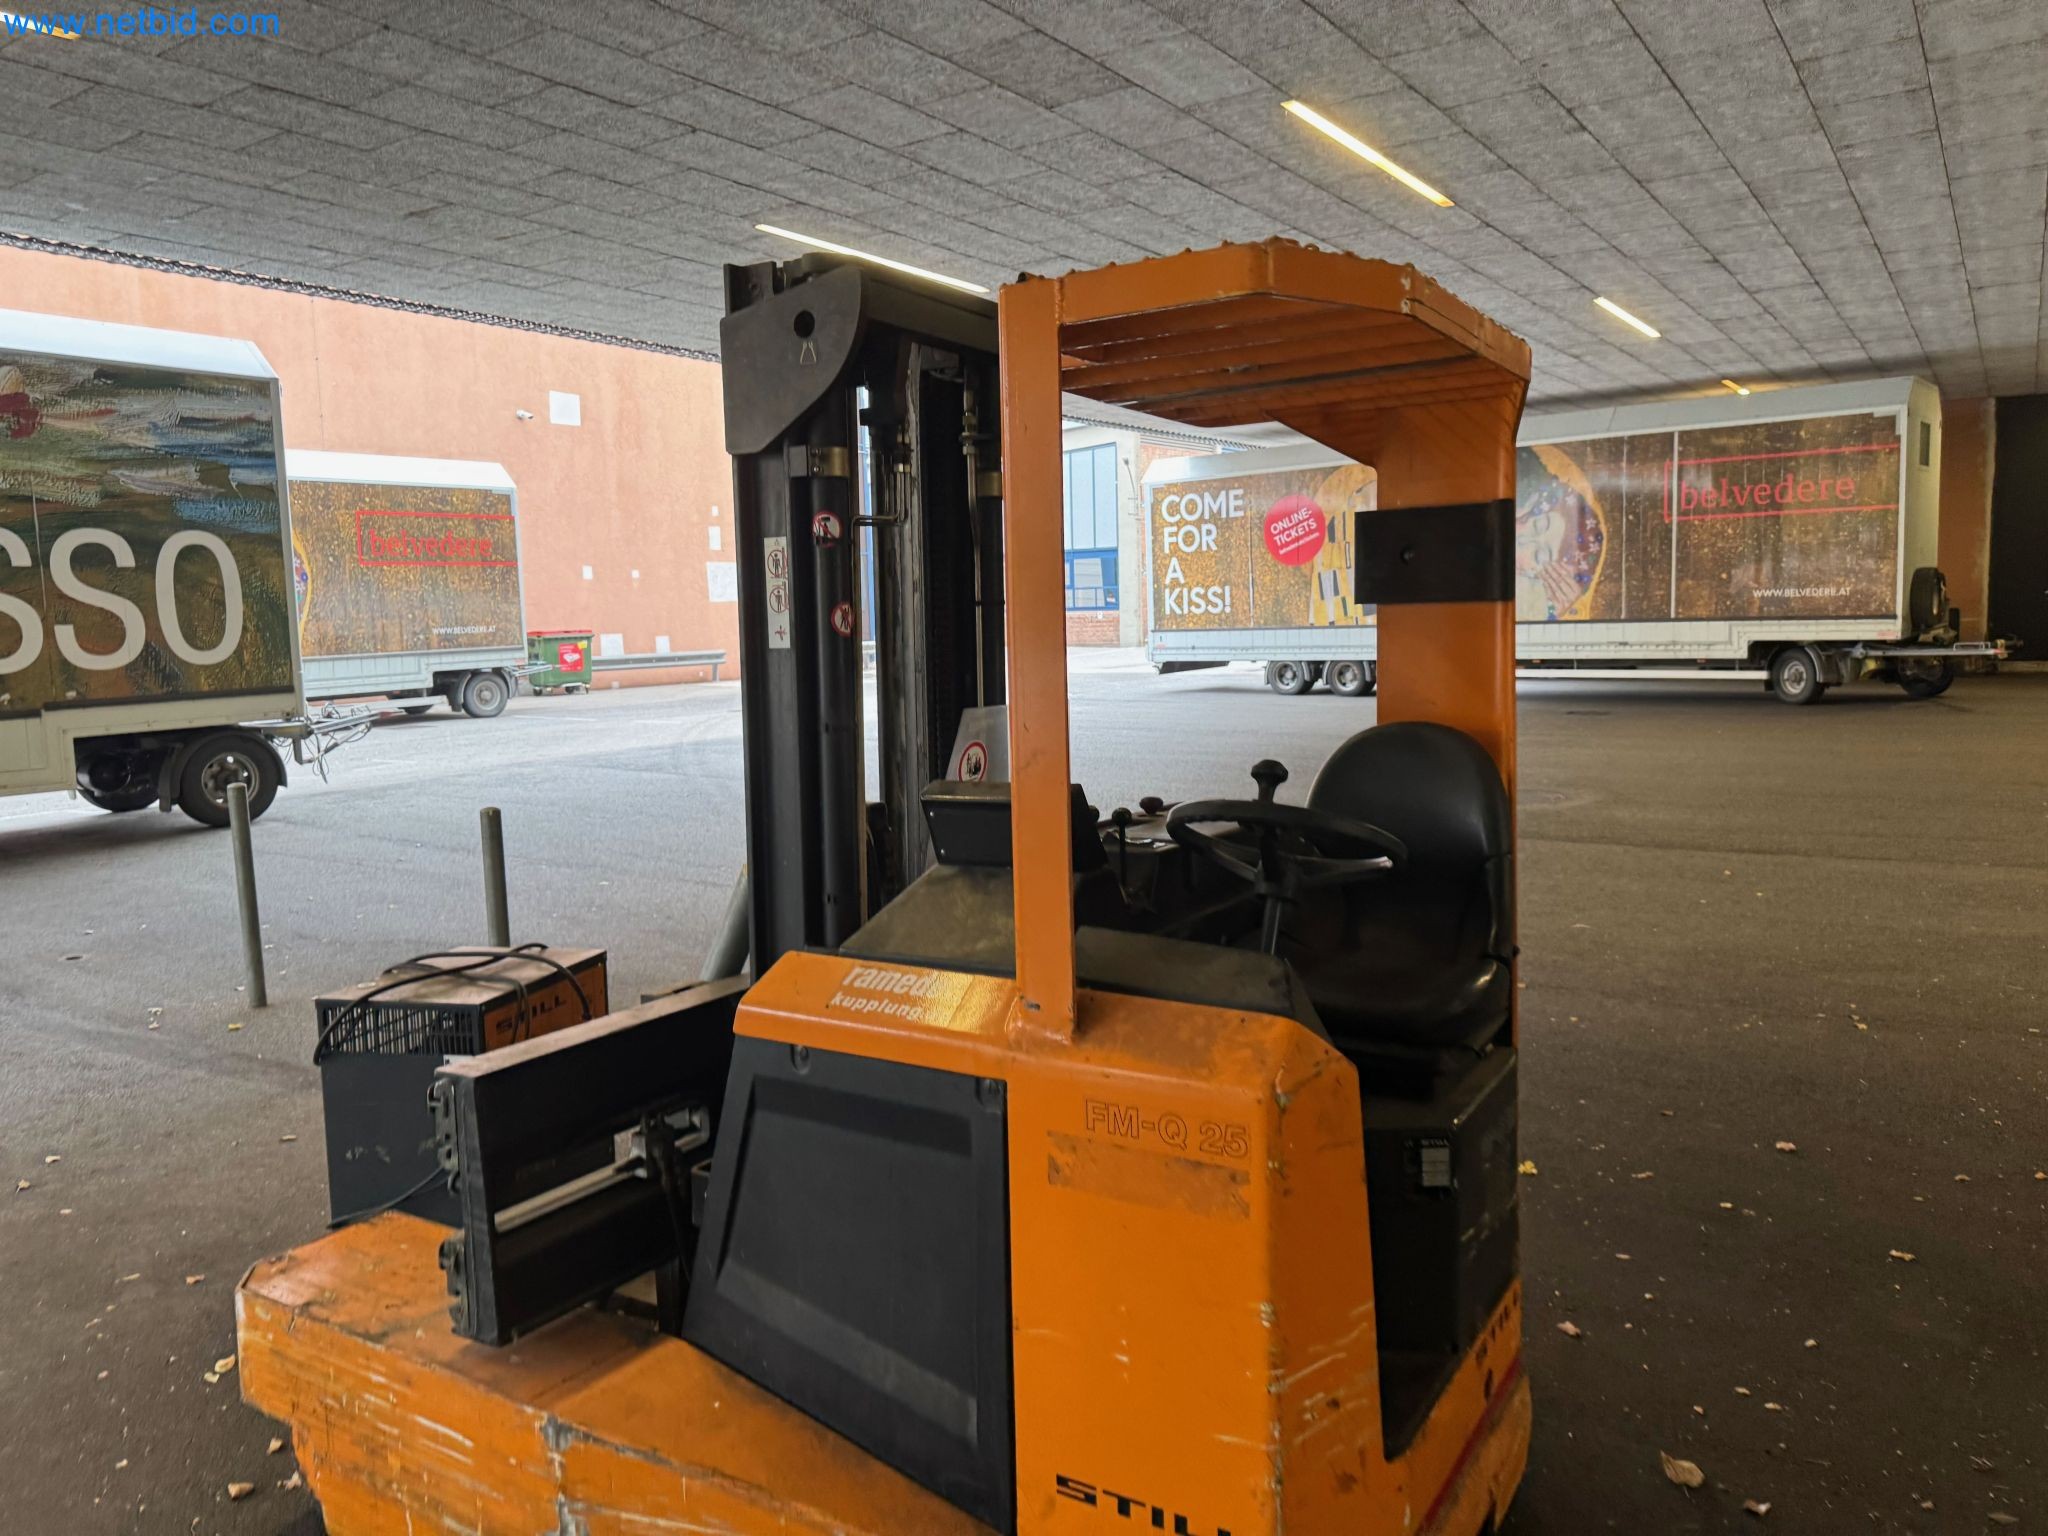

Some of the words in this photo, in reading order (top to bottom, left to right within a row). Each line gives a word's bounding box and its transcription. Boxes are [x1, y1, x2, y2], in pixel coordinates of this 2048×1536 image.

[1161, 489, 1245, 523] COME
[1680, 472, 1856, 512] belvedere
[1270, 507, 1312, 535] ONLINE-
[1273, 517, 1318, 546] TICKETS
[369, 528, 493, 557] belvedere
[1163, 523, 1218, 554] FOR
[1165, 556, 1185, 585] A
[1164, 585, 1232, 616] KISS!
[1752, 587, 1851, 598] WWW.BELVEDERE.AT
[1085, 1099, 1188, 1151] FM-Q
[1199, 1121, 1249, 1158] 25
